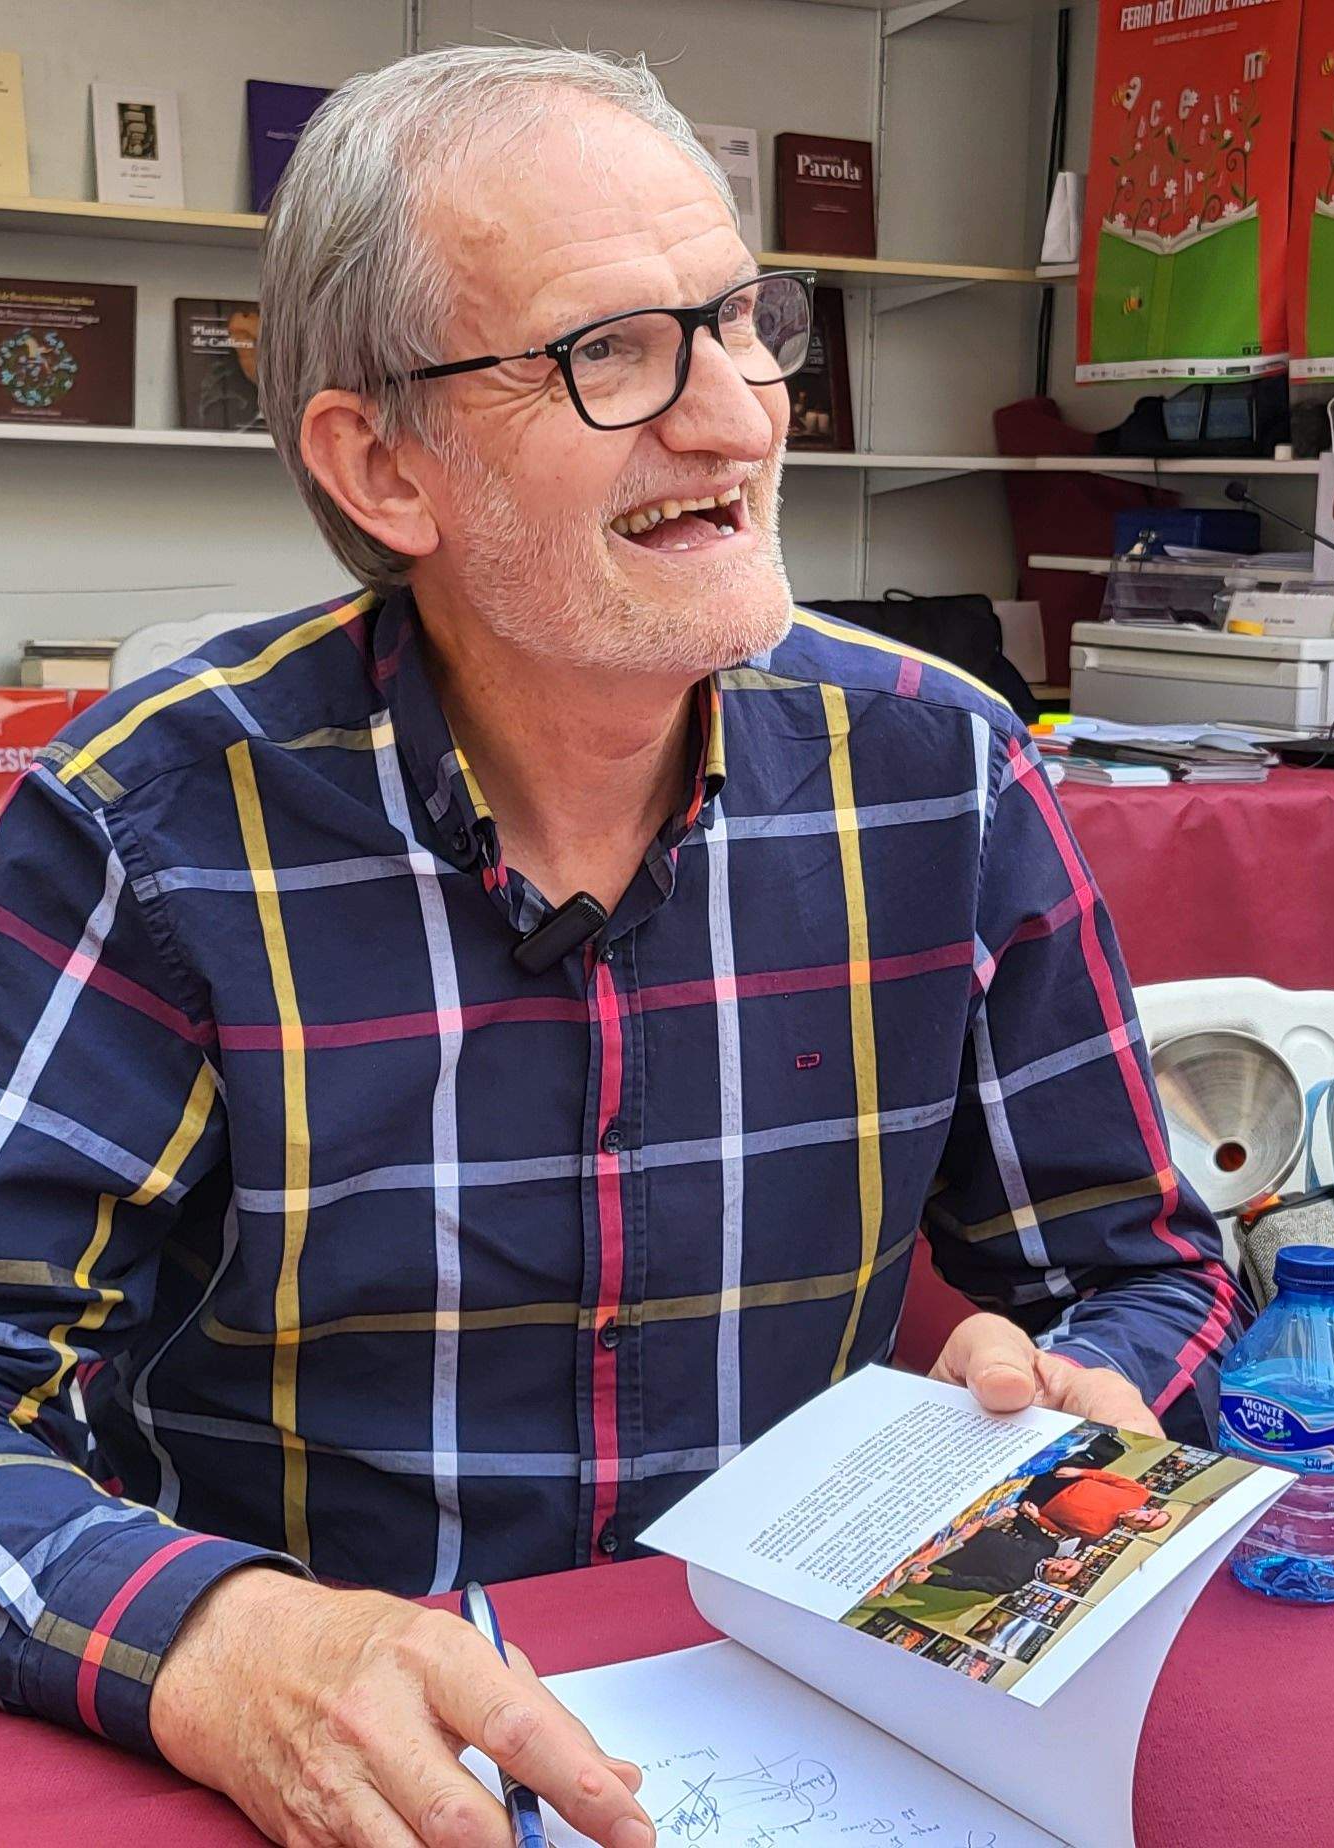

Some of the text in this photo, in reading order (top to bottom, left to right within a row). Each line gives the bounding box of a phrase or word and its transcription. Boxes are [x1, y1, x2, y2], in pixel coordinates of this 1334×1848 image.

[1120, 4, 1153, 31] FERIA
[1155, 1, 1175, 25] DEL
[797, 154, 862, 181] Parola
[192, 337, 207, 347] de
[1242, 1398, 1285, 1420] MONTE
[1247, 1409, 1284, 1430] PINOS
[1302, 1457, 1322, 1470] 330
